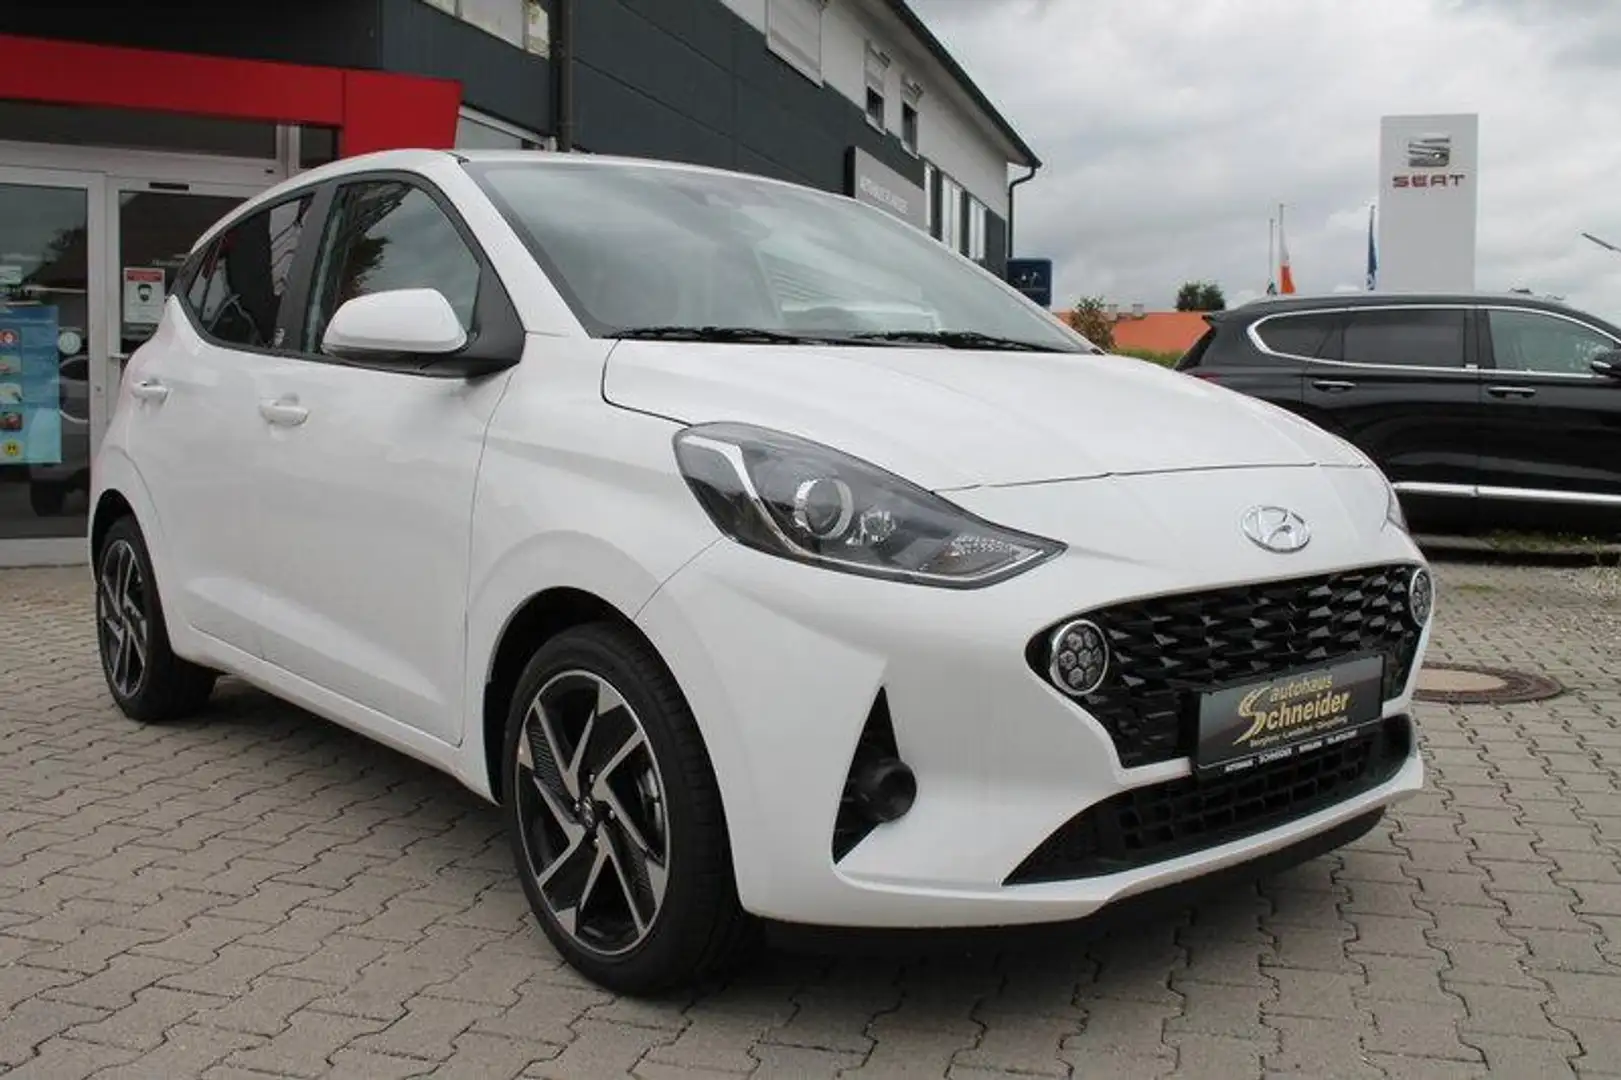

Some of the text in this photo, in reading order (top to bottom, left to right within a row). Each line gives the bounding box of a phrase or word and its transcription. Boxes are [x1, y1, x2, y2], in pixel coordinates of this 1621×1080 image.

[1392, 174, 1466, 188] SEAT
[1270, 674, 1333, 702] autohaus
[1232, 684, 1350, 745] Schneider
